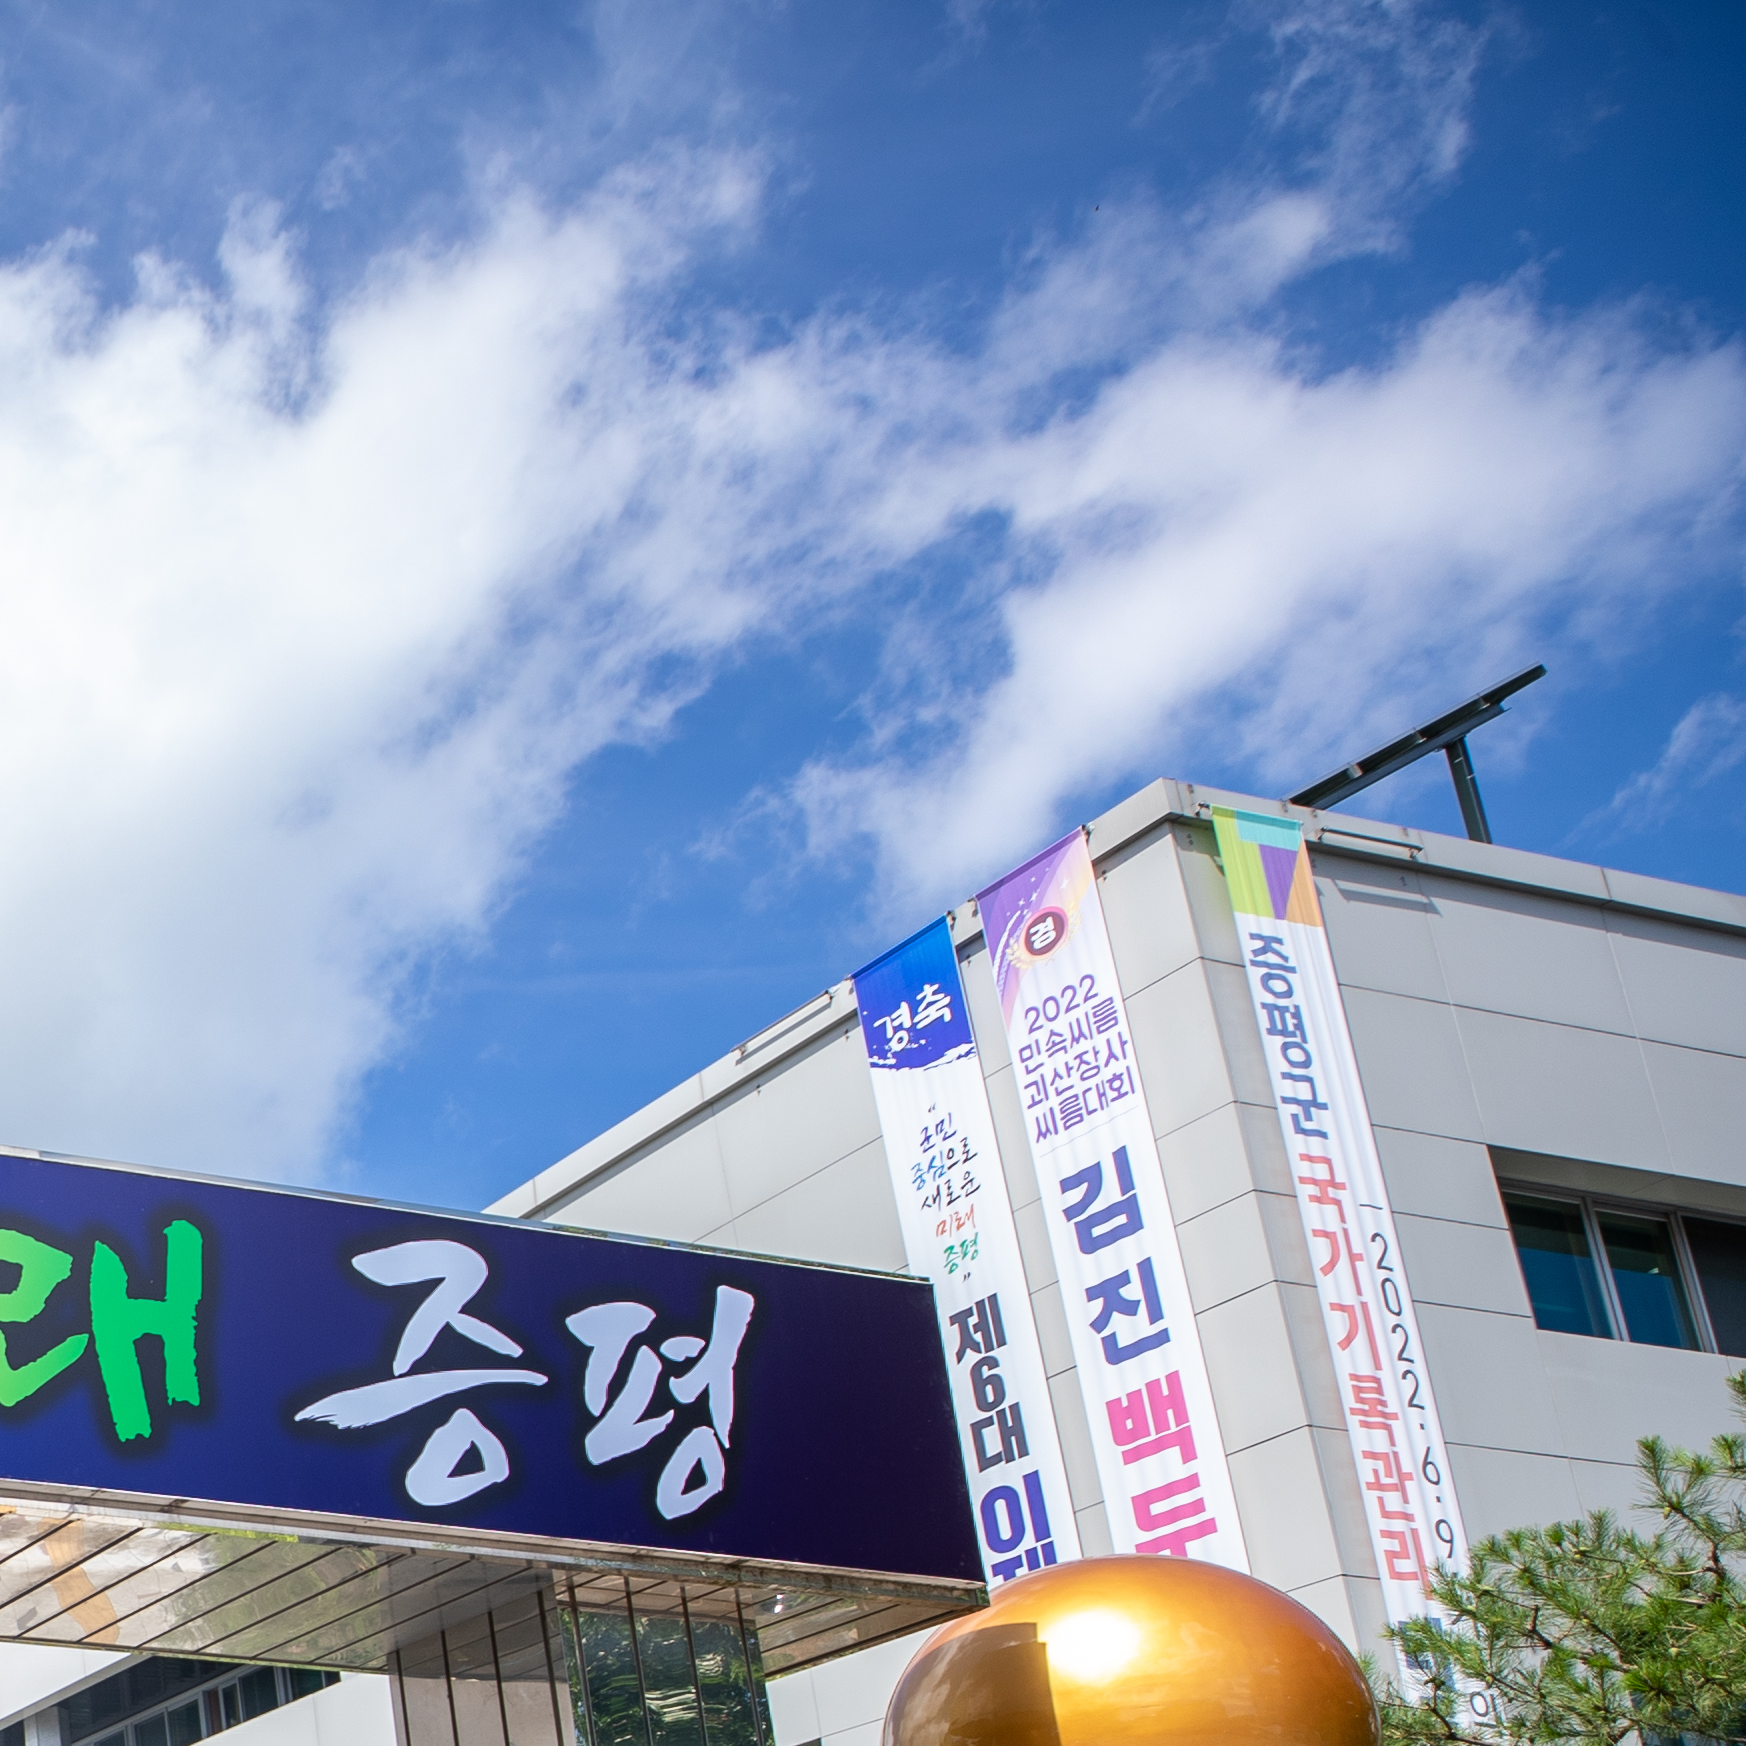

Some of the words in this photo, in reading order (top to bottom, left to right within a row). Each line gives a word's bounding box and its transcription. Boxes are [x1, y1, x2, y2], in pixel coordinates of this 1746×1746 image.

[873, 983, 952, 1053] 경축
[1018, 996, 1118, 1075] 민속씨름
[1024, 973, 1099, 1035] 2022
[1249, 932, 1329, 1140] 증평군
[1023, 1031, 1129, 1110] 괴산장사
[1035, 1065, 1135, 1143] 씨름대회
[911, 1136, 978, 1191] 중심으로
[920, 1112, 957, 1153] 군민
[920, 1170, 981, 1211] 새로운
[936, 1204, 977, 1237] 미래
[943, 1232, 979, 1274] 증평
[1060, 1144, 1172, 1366] 김진
[294, 1237, 757, 1520] 증평
[948, 1292, 1029, 1473] 제6대
